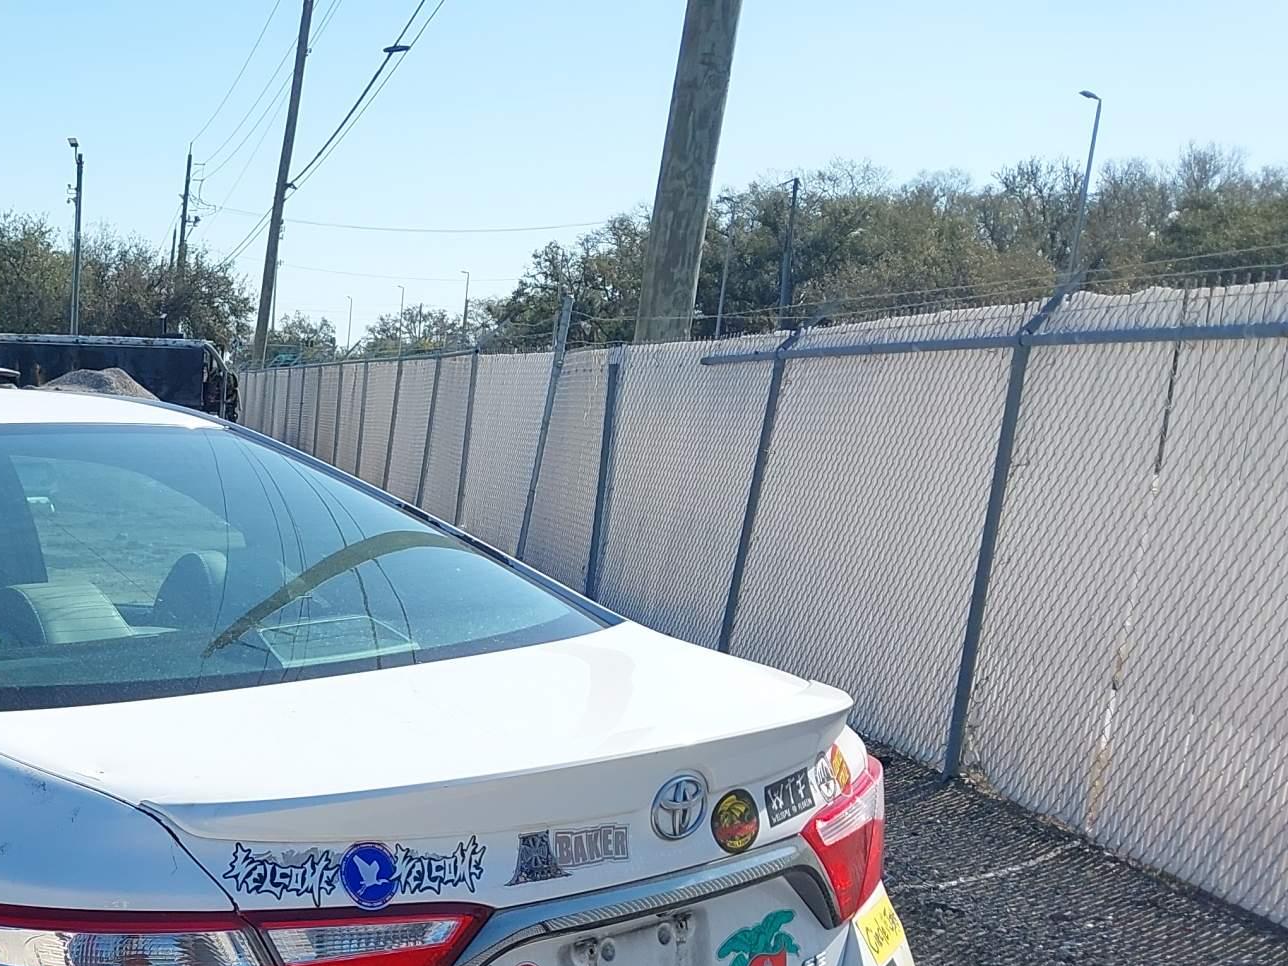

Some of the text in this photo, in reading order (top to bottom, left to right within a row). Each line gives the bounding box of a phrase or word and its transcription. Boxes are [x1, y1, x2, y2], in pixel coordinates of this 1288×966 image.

[223, 842, 340, 908] WELCOME
[389, 834, 487, 894] WELCOME
[555, 828, 627, 866] BAKER
